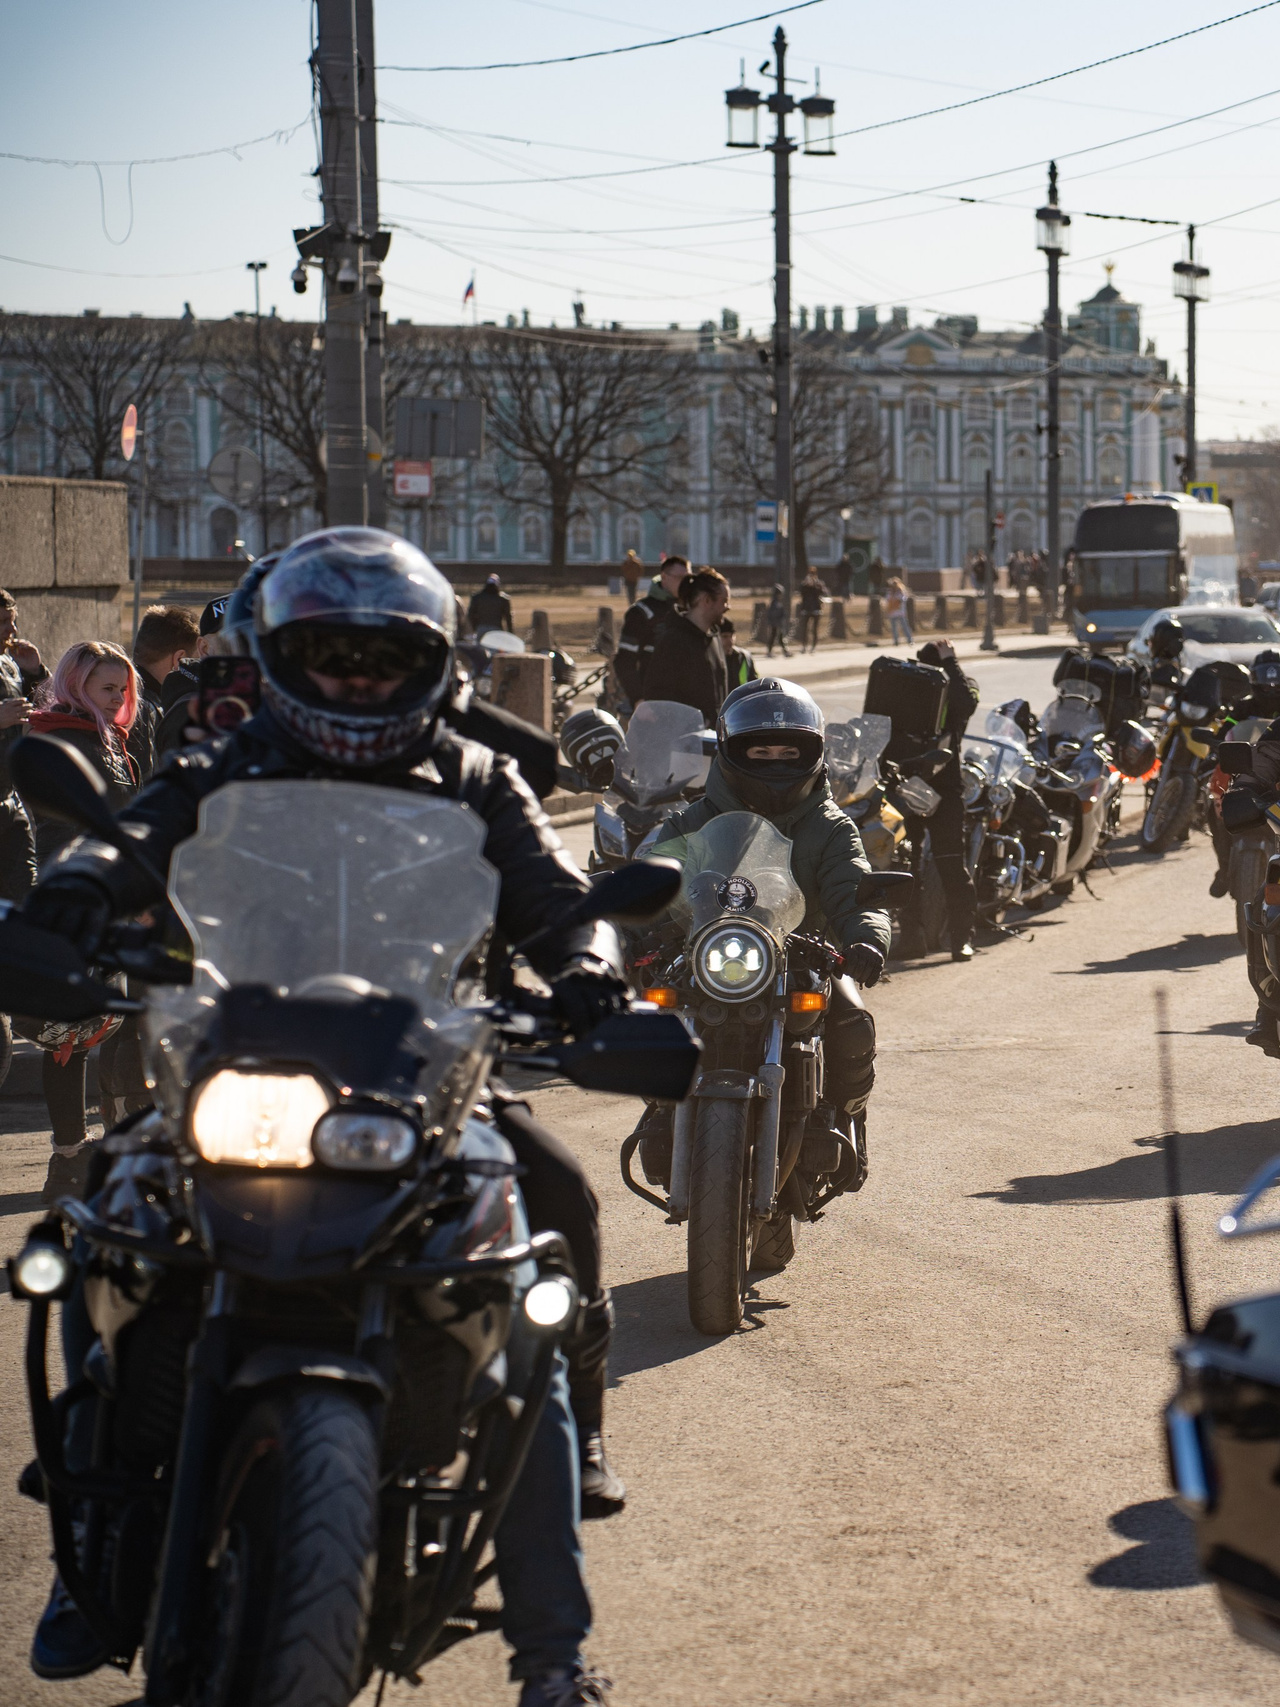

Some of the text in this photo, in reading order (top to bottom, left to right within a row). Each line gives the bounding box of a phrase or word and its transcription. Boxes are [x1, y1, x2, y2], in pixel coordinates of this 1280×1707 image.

[718, 878, 756, 897] THE HOOLIGANS
[724, 904, 746, 912] FAMILY
